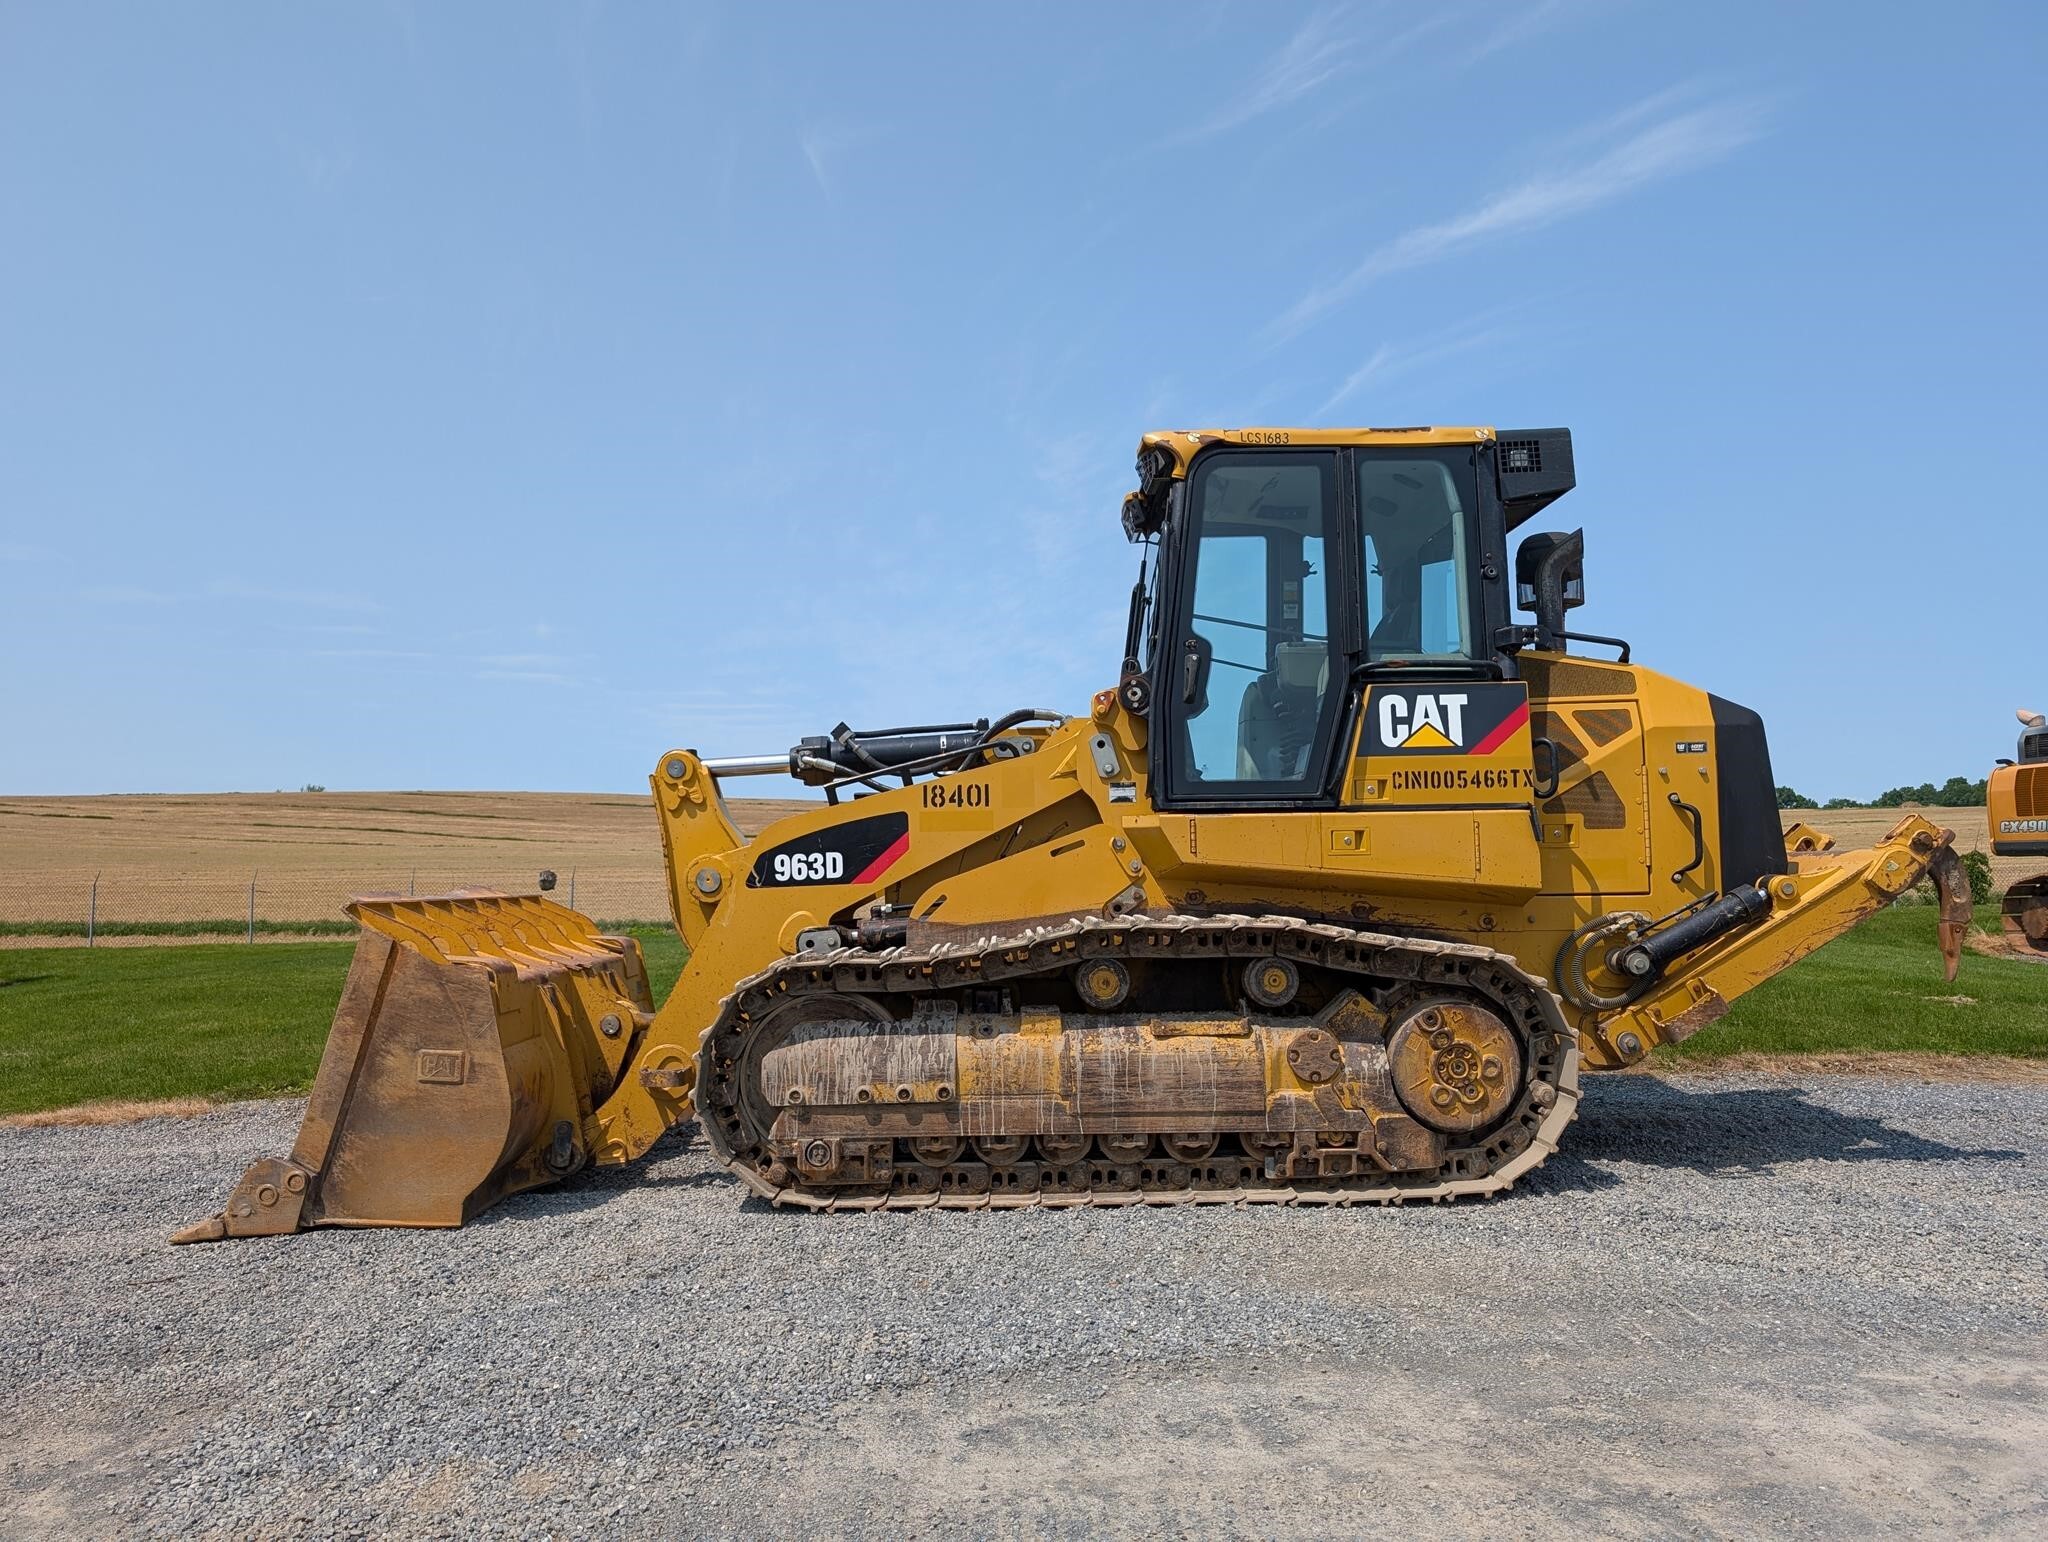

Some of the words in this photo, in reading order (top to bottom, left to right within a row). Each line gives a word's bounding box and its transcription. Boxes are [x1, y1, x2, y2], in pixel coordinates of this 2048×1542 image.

[1240, 432, 1289, 444] LCS1683
[1379, 694, 1468, 748] CAT
[923, 783, 990, 808] 18401
[2000, 820, 2048, 833] CX490
[774, 852, 844, 881] 963D
